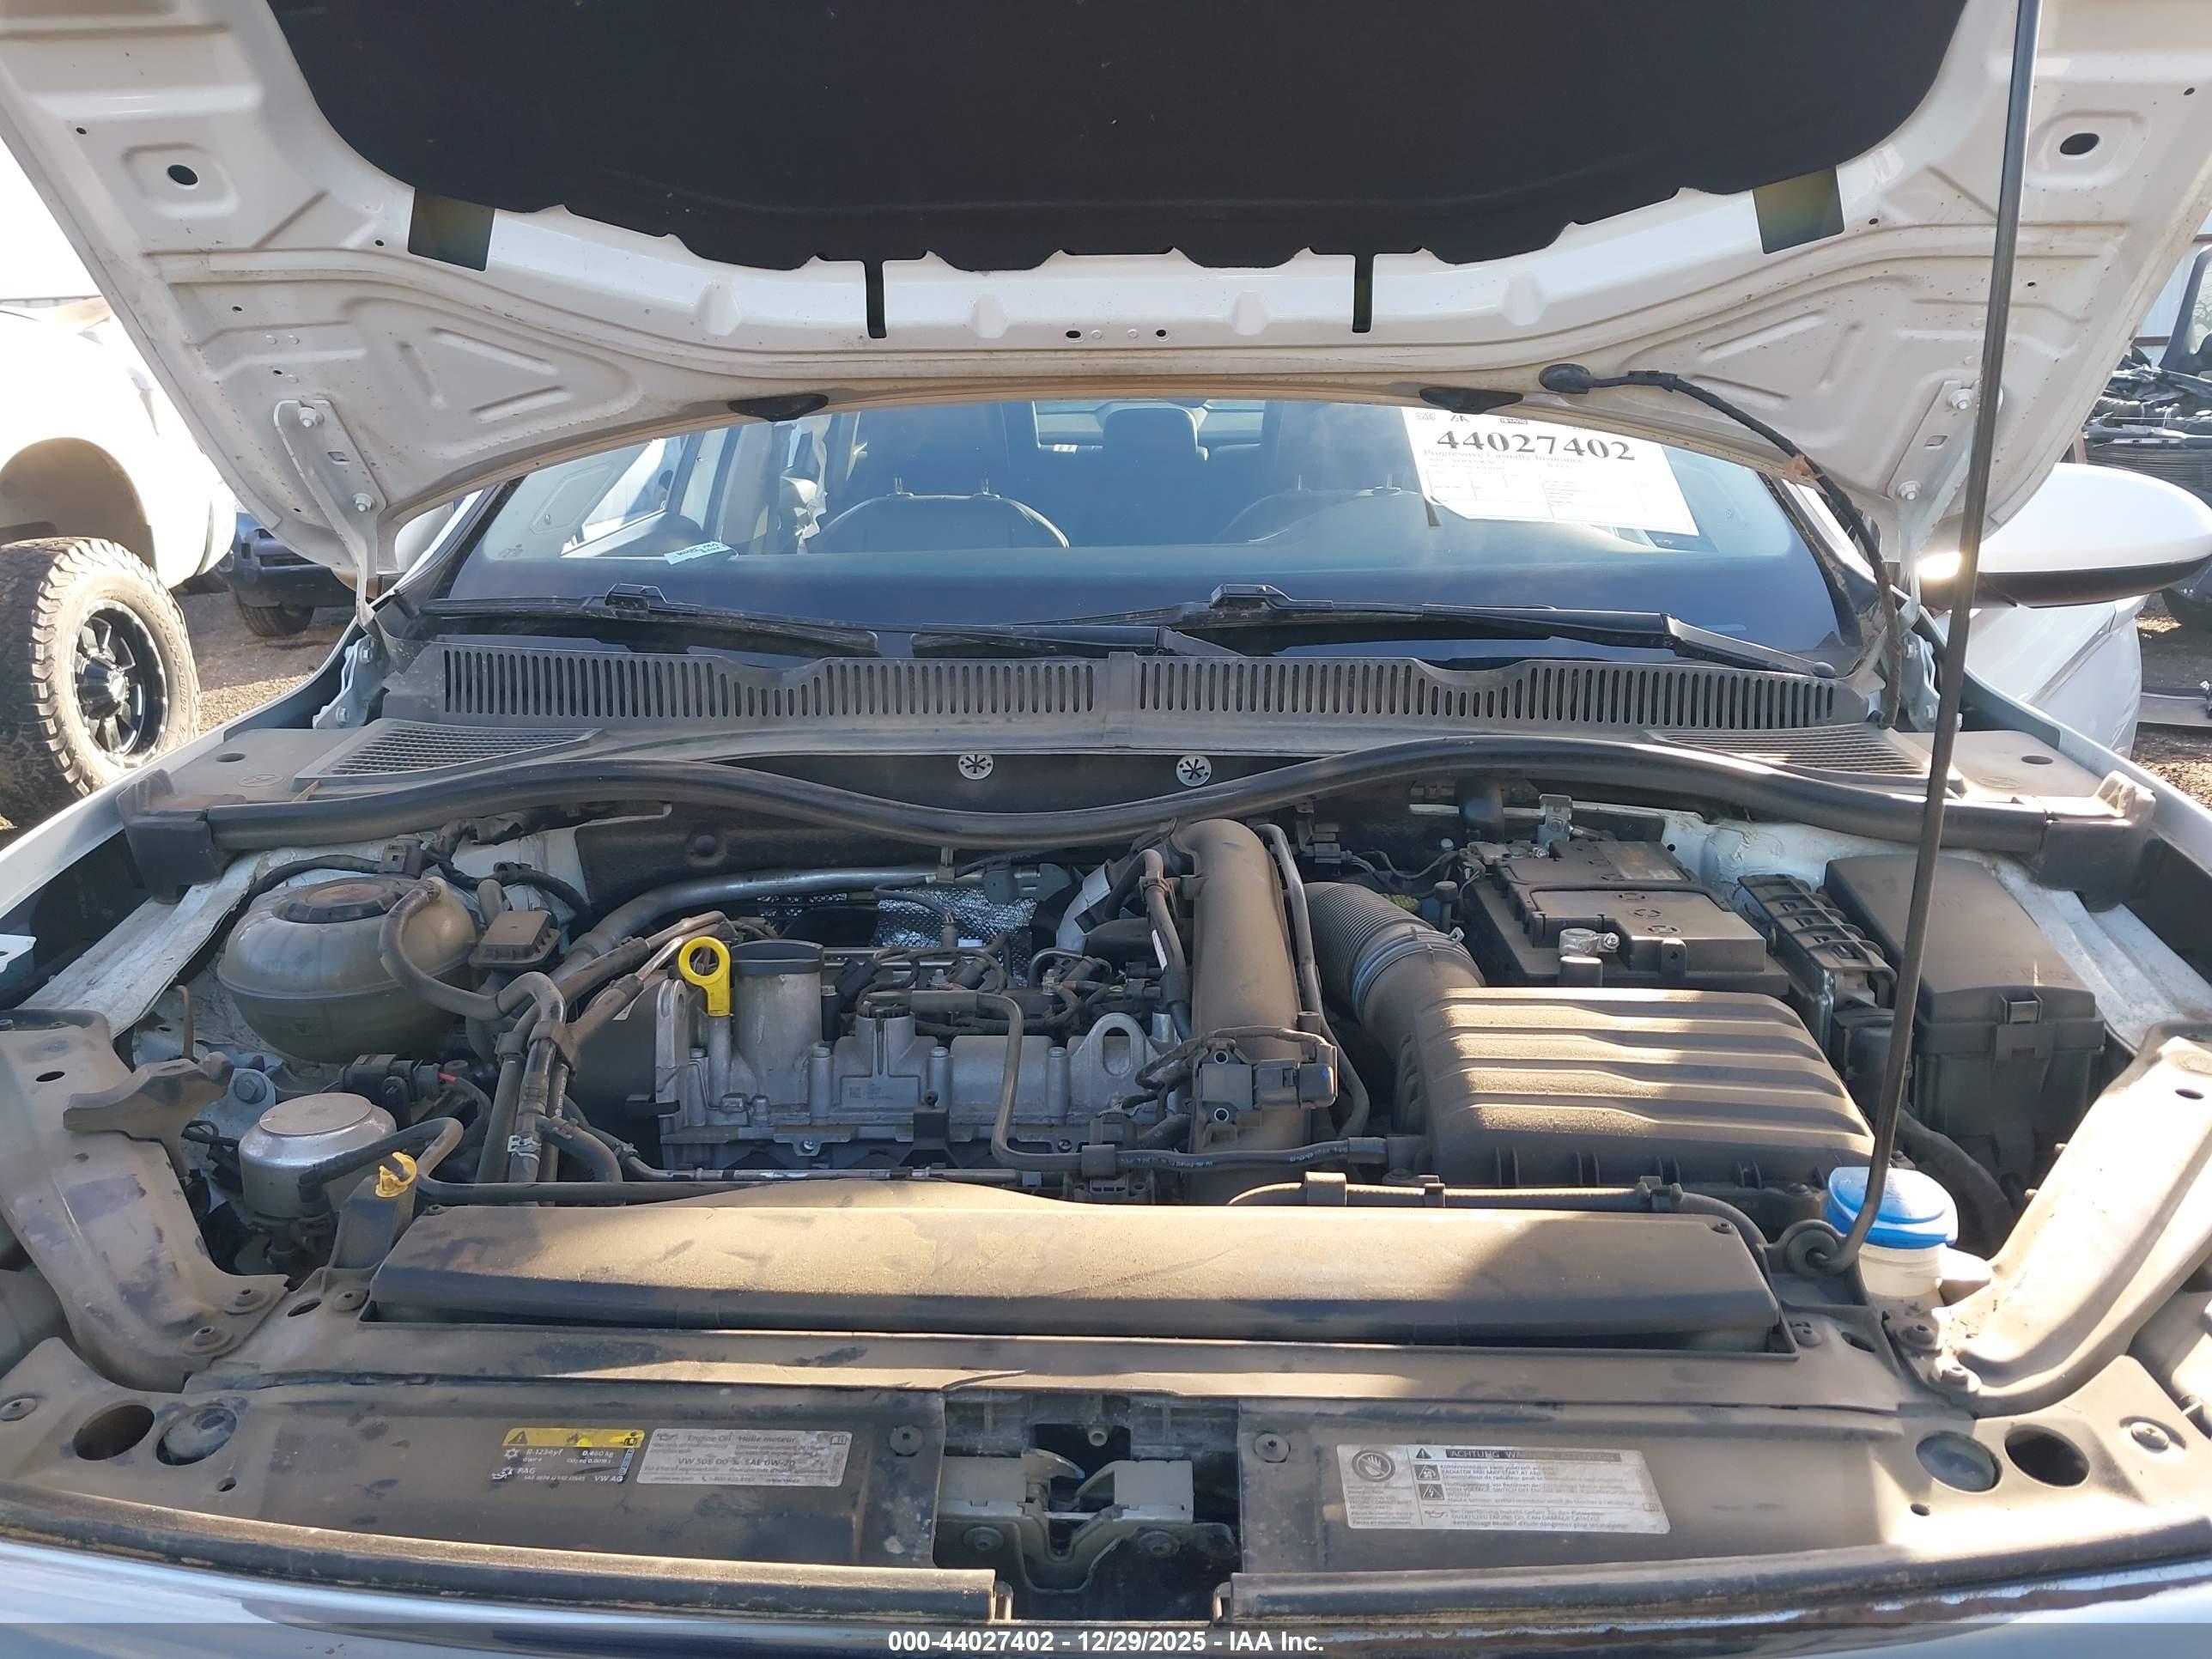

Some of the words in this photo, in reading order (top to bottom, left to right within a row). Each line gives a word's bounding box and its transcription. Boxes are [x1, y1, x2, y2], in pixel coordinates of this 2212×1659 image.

[1437, 430, 1636, 461] 44027402
[687, 1435, 716, 1443] Engine
[526, 1449, 563, 1457] R-1234yf
